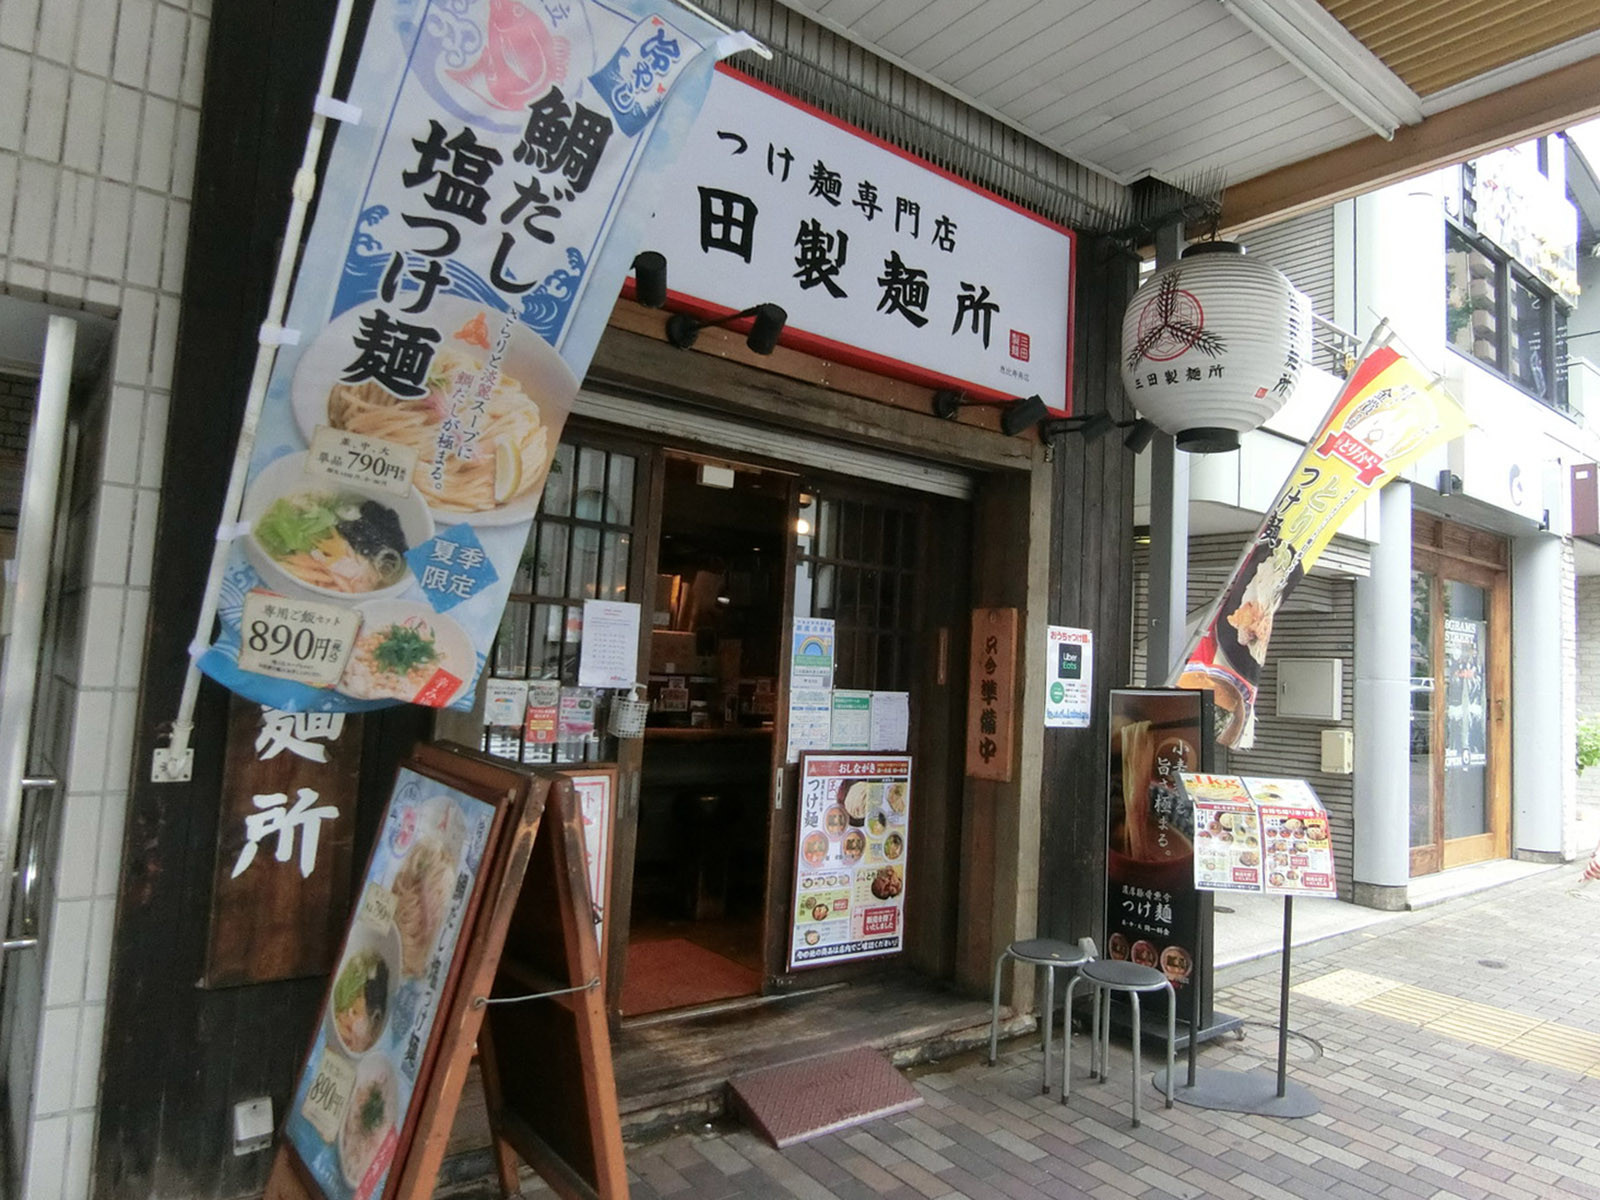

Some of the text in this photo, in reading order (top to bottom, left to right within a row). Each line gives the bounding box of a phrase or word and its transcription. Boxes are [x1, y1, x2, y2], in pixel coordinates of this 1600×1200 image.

[489, 86, 613, 294] 鯛だし
[717, 130, 958, 253] つけ麺専門店
[340, 118, 504, 398] 塩つけ麺
[697, 186, 1000, 350] 田製麺所
[1134, 364, 1225, 390] 三田製麺所
[347, 450, 400, 480] 790円
[429, 536, 487, 571] 夏季
[420, 564, 477, 599] 限定
[264, 604, 342, 626] 専用ご飯セット
[248, 620, 332, 662] 890円
[1063, 652, 1078, 662] Uber
[1063, 661, 1077, 670] Eats
[979, 635, 998, 764] 只今準備中
[839, 762, 876, 774] おしながき
[804, 779, 820, 828] つけ麺
[1122, 900, 1173, 924] つけ麺
